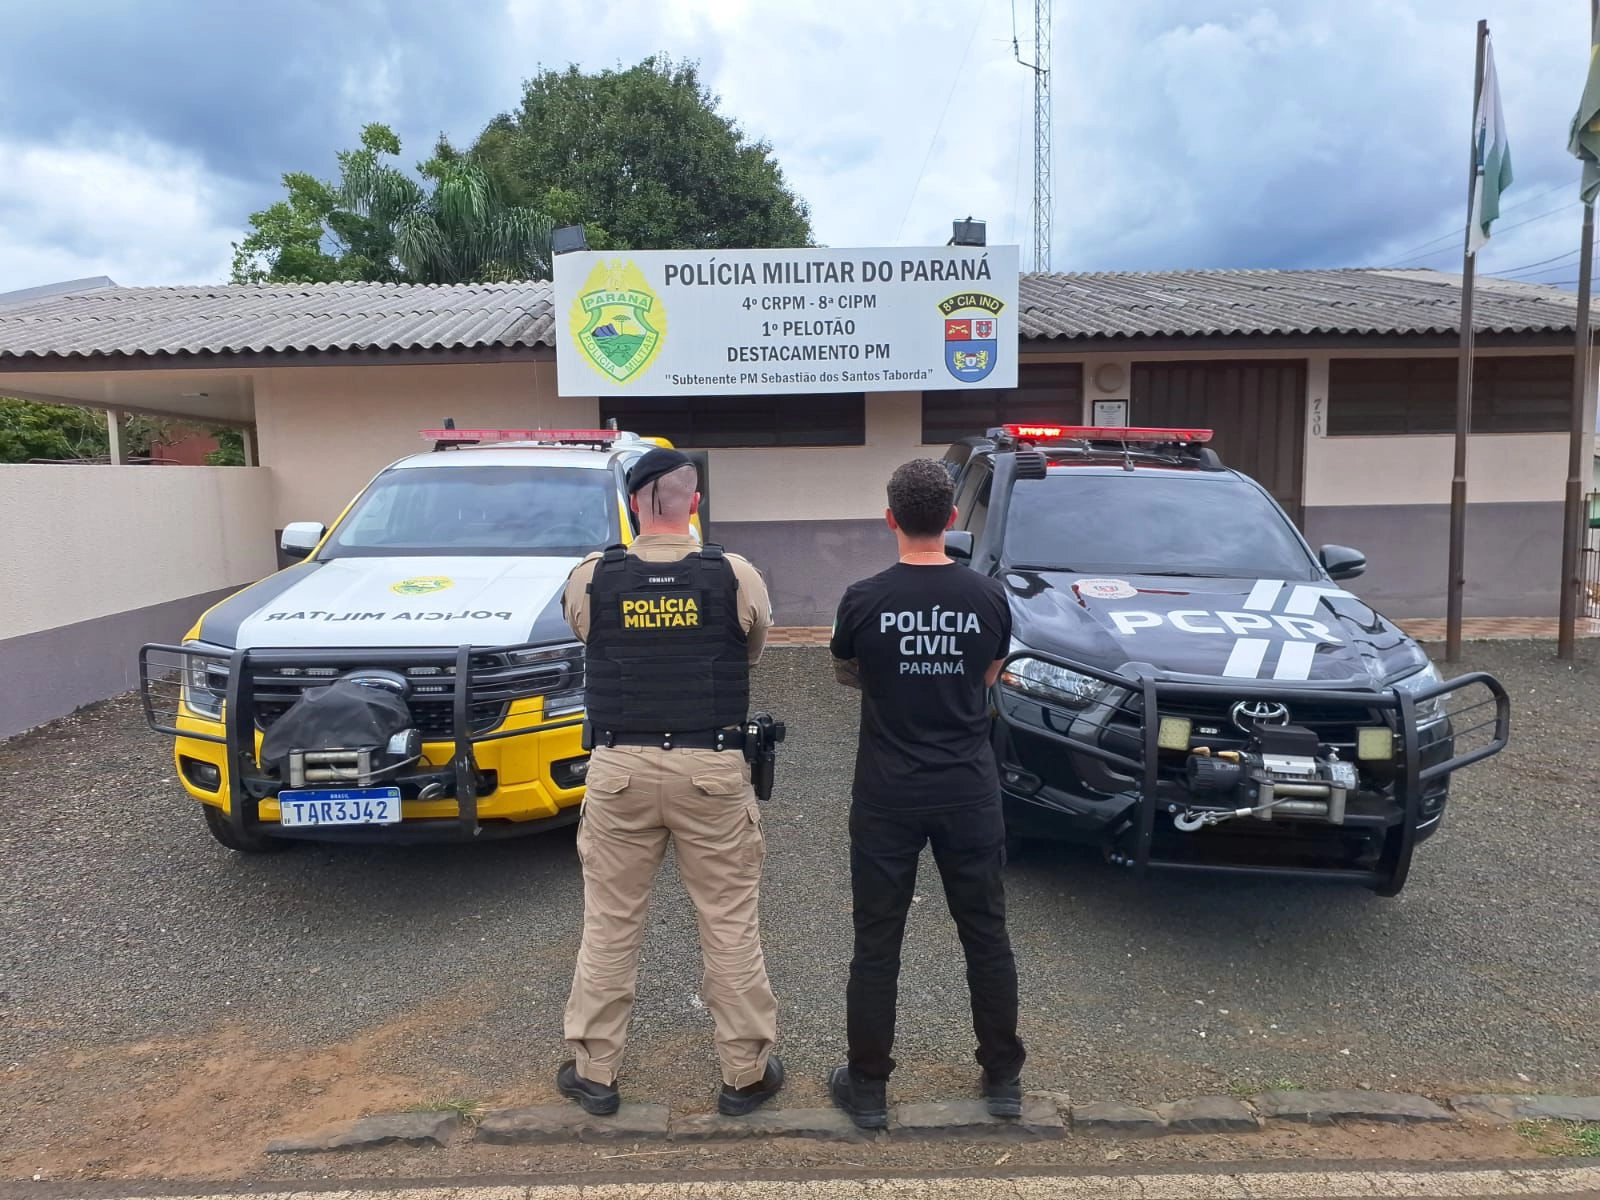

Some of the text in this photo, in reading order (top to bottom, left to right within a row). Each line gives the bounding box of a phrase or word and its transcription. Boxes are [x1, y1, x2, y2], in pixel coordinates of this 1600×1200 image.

[664, 252, 992, 286] POLÍCIA MILITAR DO PARANÁ
[761, 296, 806, 311] CRPM
[838, 294, 877, 309] CIPM
[957, 295, 977, 307] CIA
[979, 296, 1000, 310] IND
[783, 316, 855, 337] PELOTÃO
[624, 334, 655, 373] MILITAR
[727, 343, 890, 362] DESTACAMENTO PM
[665, 374, 737, 385] "Subtenente
[740, 373, 758, 384] PM
[761, 371, 817, 384] Sebastião
[819, 371, 839, 383] dos
[841, 370, 881, 382] Santos
[622, 596, 698, 614] POLÍCIA
[624, 612, 698, 628] MILITAR
[880, 604, 981, 634] POLÍCIA
[1108, 610, 1343, 642] PCPR
[899, 634, 963, 656] CIVIL
[899, 659, 965, 675] PARANÁ
[293, 800, 388, 823] TAR3J42
